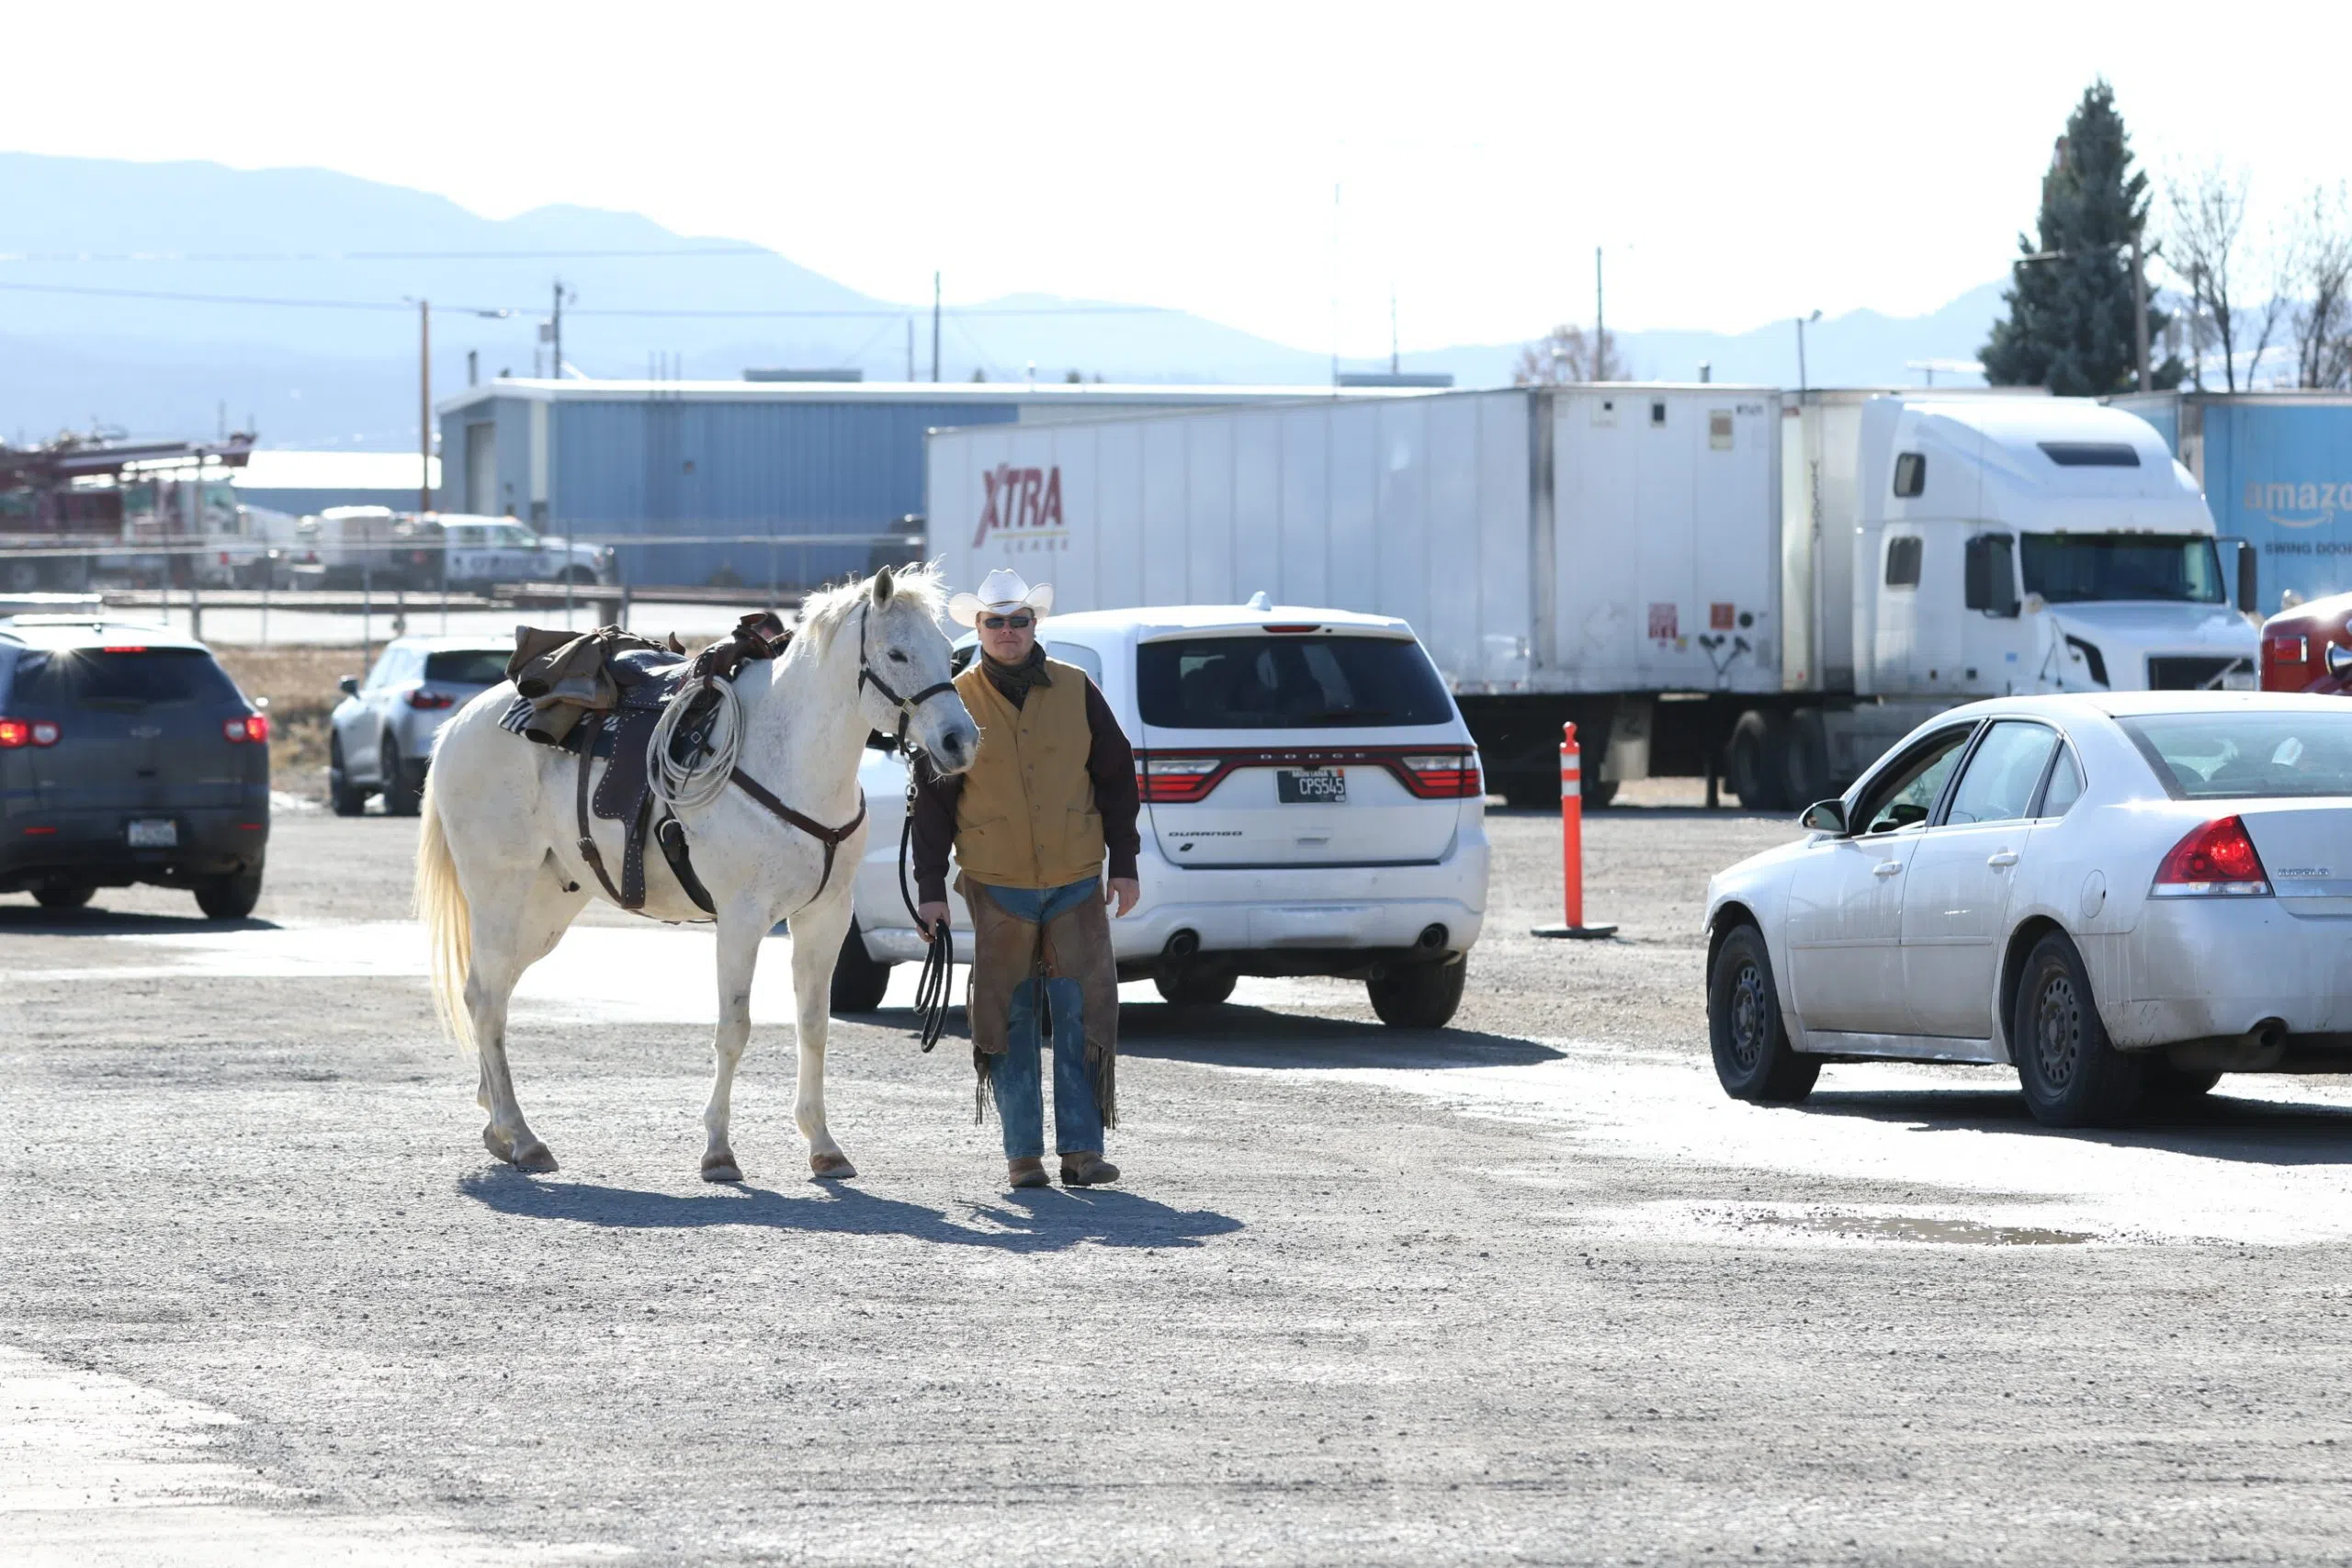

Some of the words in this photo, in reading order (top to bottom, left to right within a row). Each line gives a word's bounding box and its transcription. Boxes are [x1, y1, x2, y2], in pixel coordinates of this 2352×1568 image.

[973, 462, 1063, 548] XTRA
[2265, 543, 2312, 555] SWING
[1299, 778, 1344, 795] CPS545
